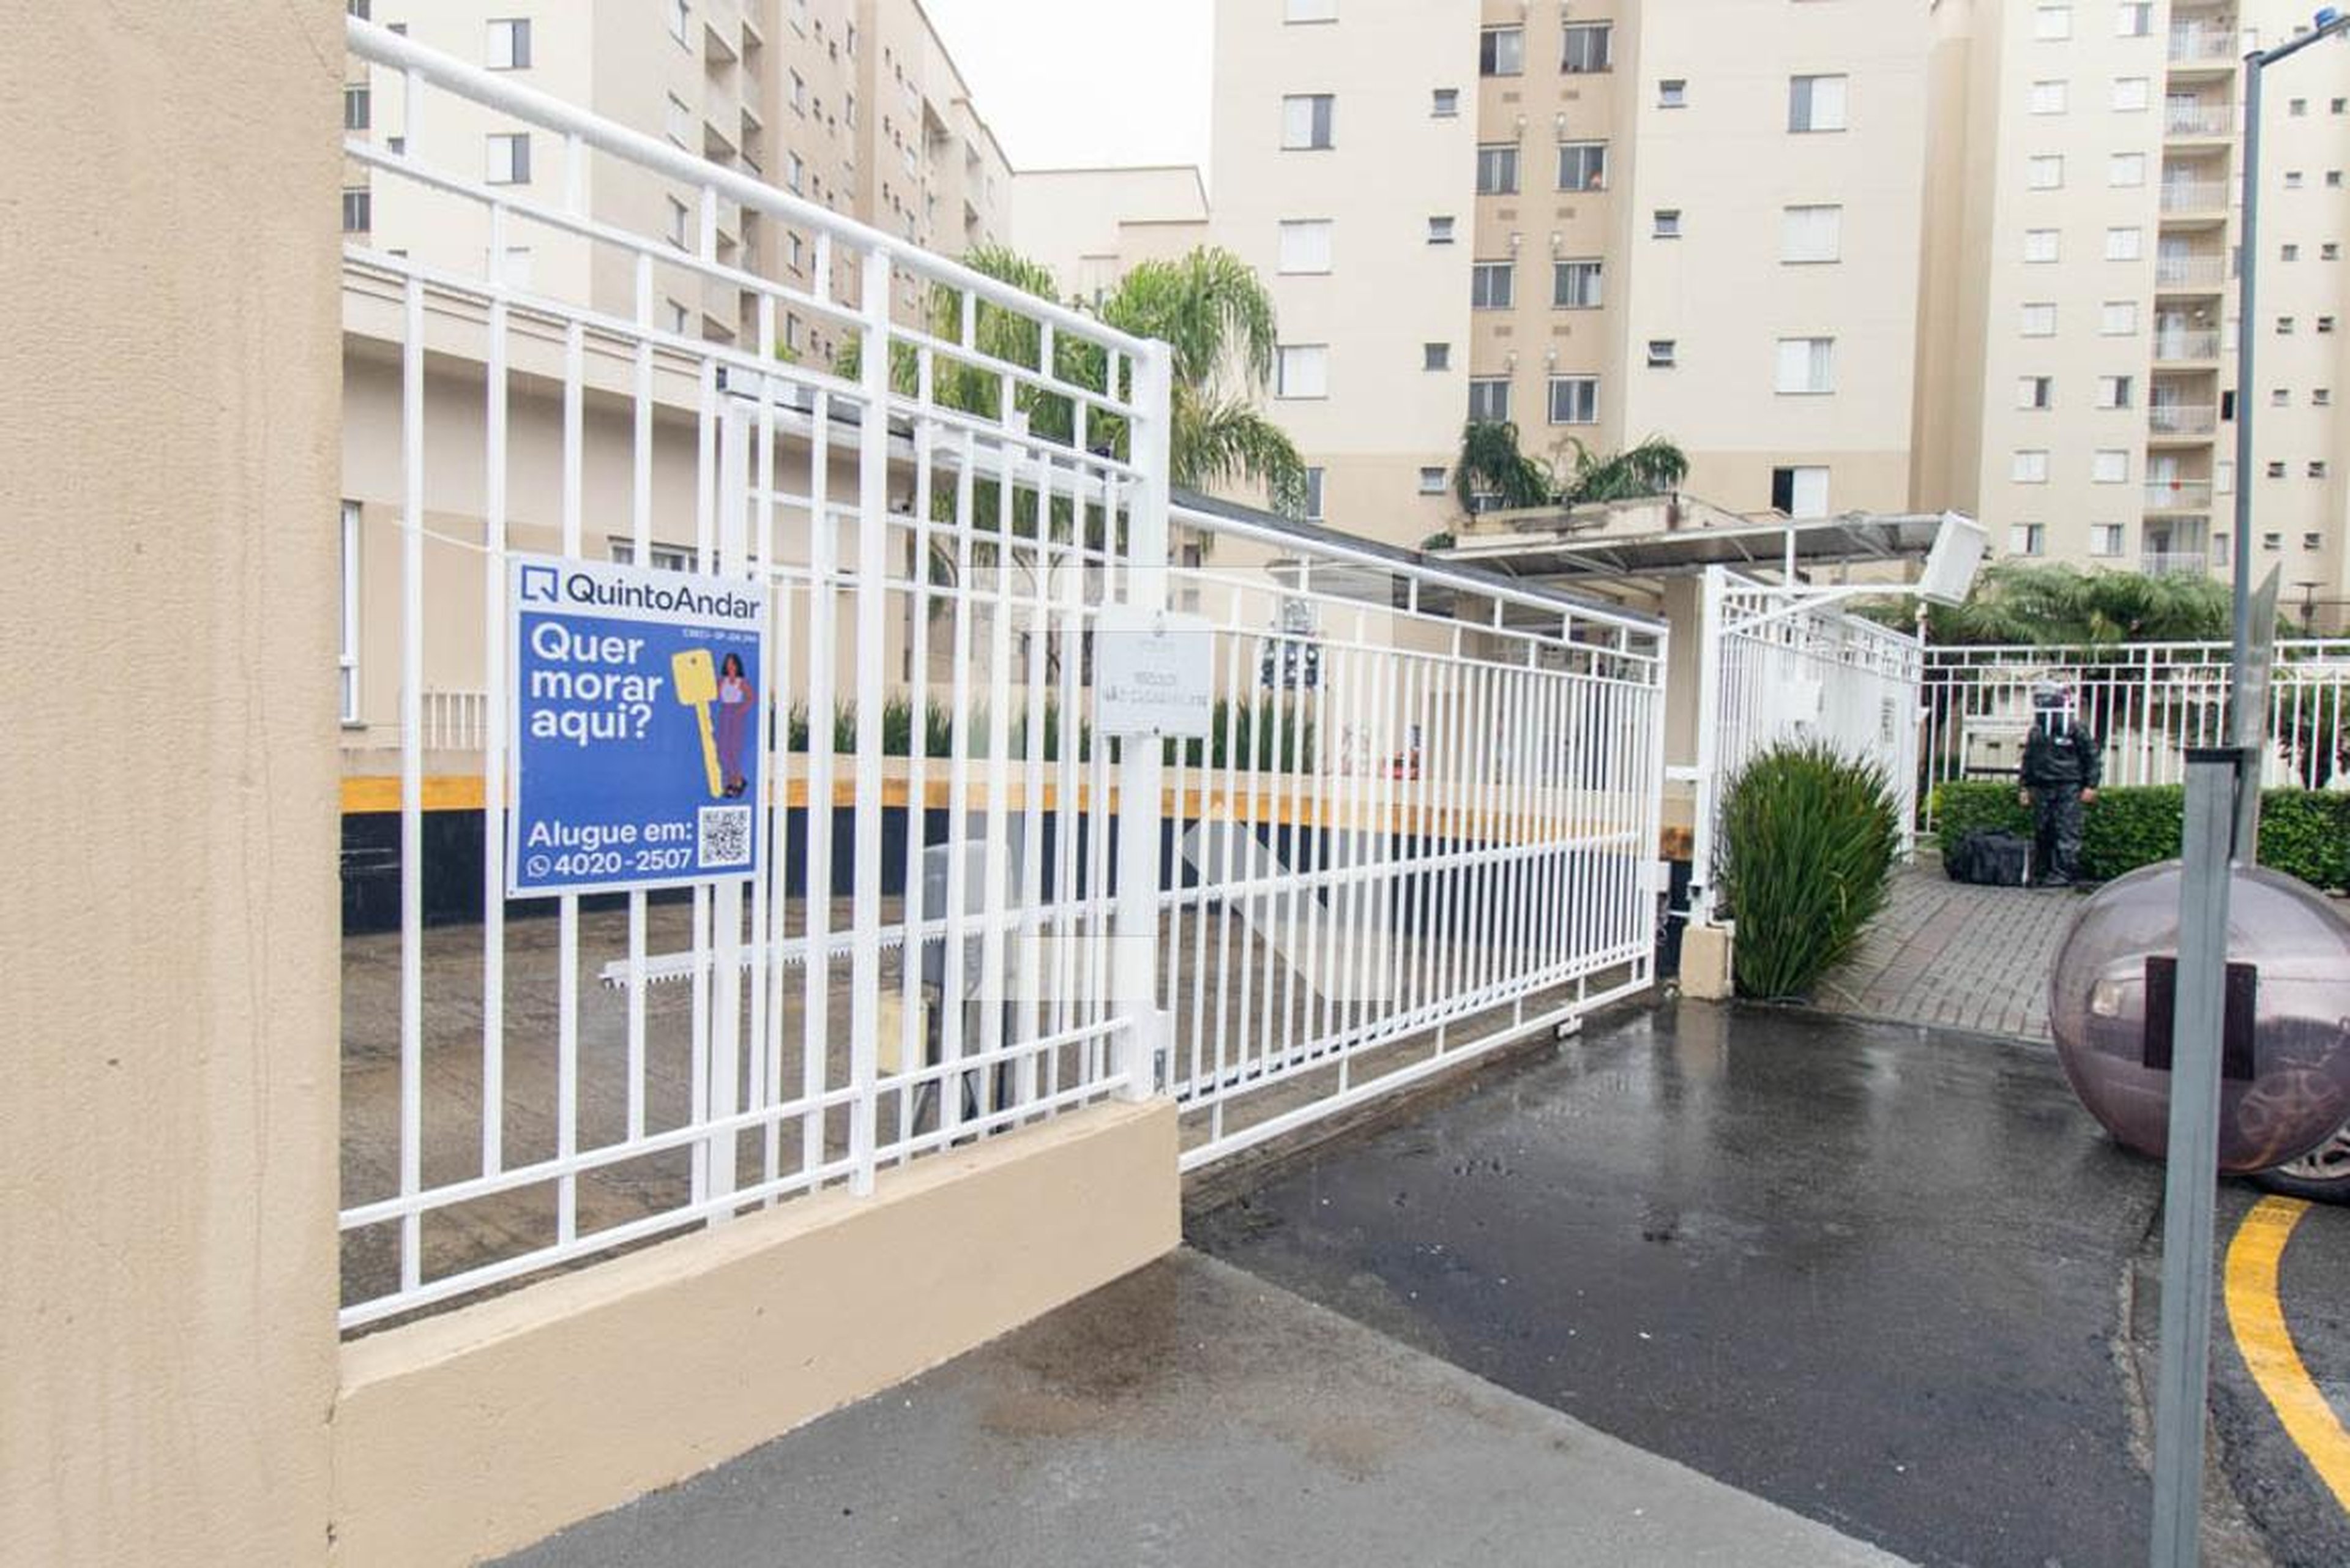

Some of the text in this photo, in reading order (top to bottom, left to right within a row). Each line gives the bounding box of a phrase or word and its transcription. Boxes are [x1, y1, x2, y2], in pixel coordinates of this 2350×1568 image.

[566, 573, 761, 619] QuintoAndar
[531, 622, 645, 665] Quer
[531, 670, 664, 703] morar
[531, 703, 652, 747] aqui?
[528, 821, 693, 850] Alugue em:
[554, 848, 693, 875] 4020-2507
